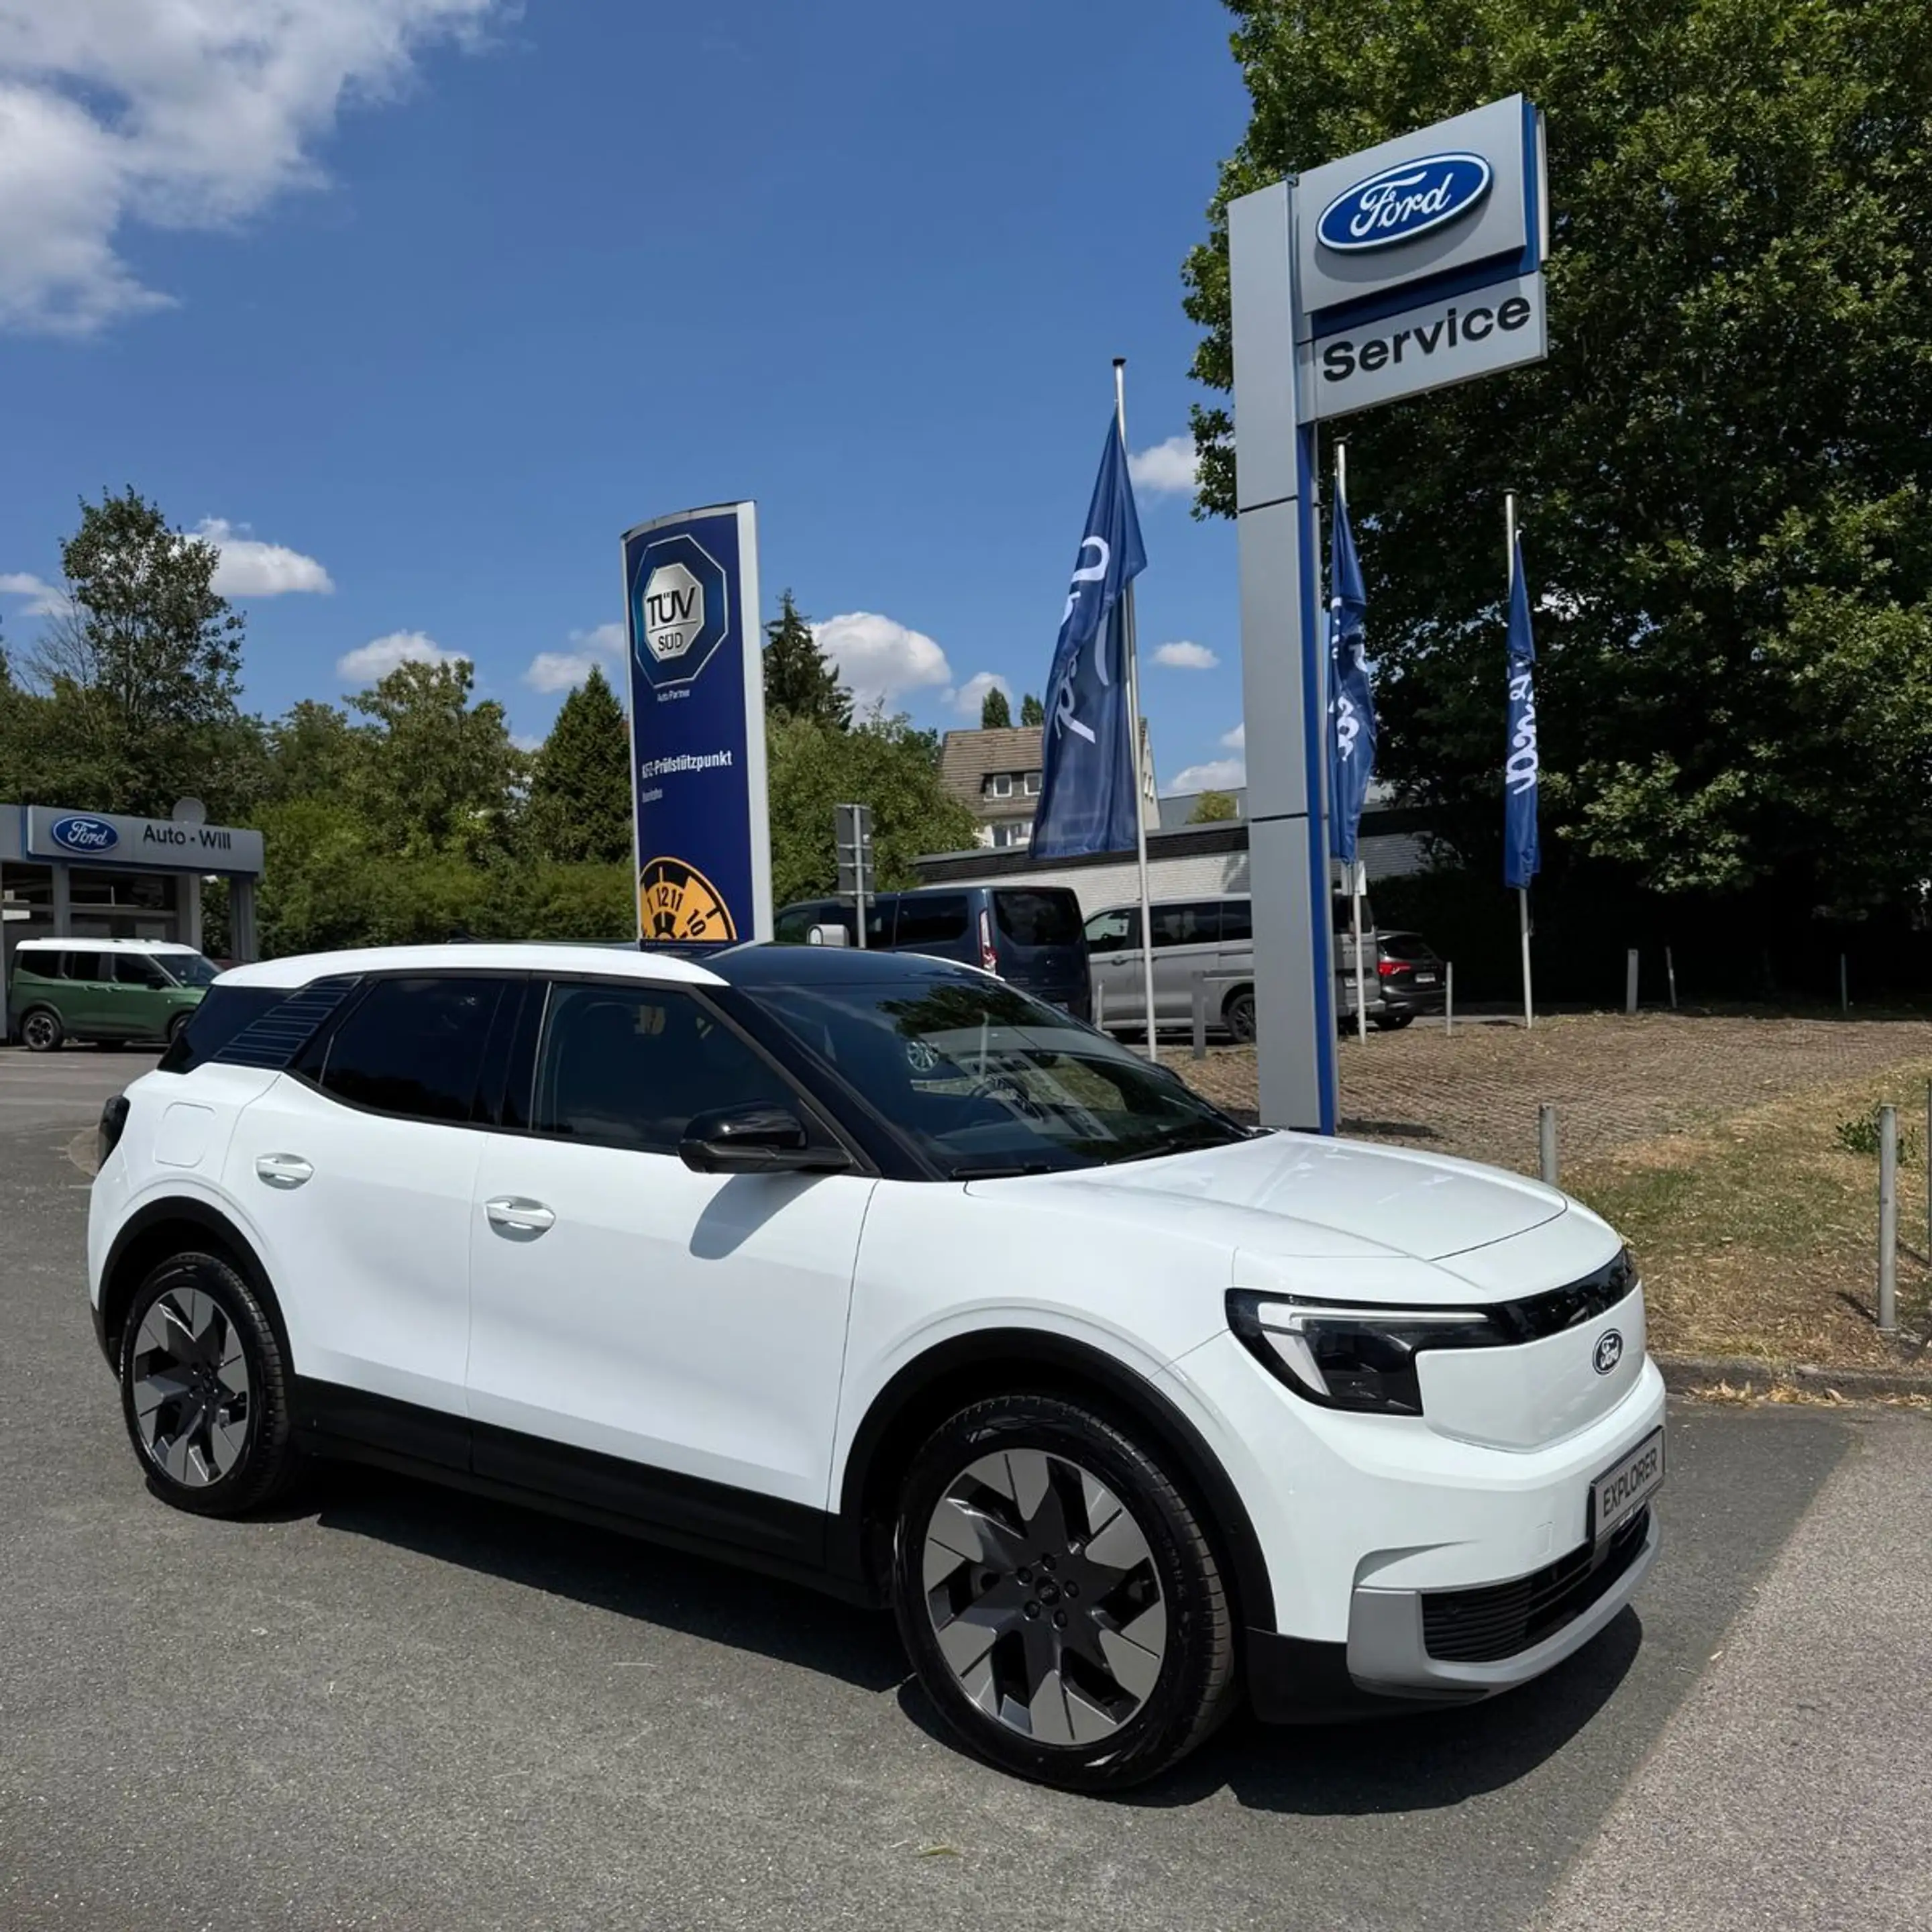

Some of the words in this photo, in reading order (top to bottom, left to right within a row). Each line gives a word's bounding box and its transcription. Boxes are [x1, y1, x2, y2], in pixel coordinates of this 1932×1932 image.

[1350, 171, 1454, 237] Ford
[1323, 296, 1531, 382] Service
[646, 586, 696, 627] TÜV
[658, 632, 683, 651] SÜD
[68, 821, 107, 845] Ford
[143, 824, 186, 845] Auto
[199, 828, 231, 851] Will
[1603, 1447, 1658, 1518] EXPLORER
